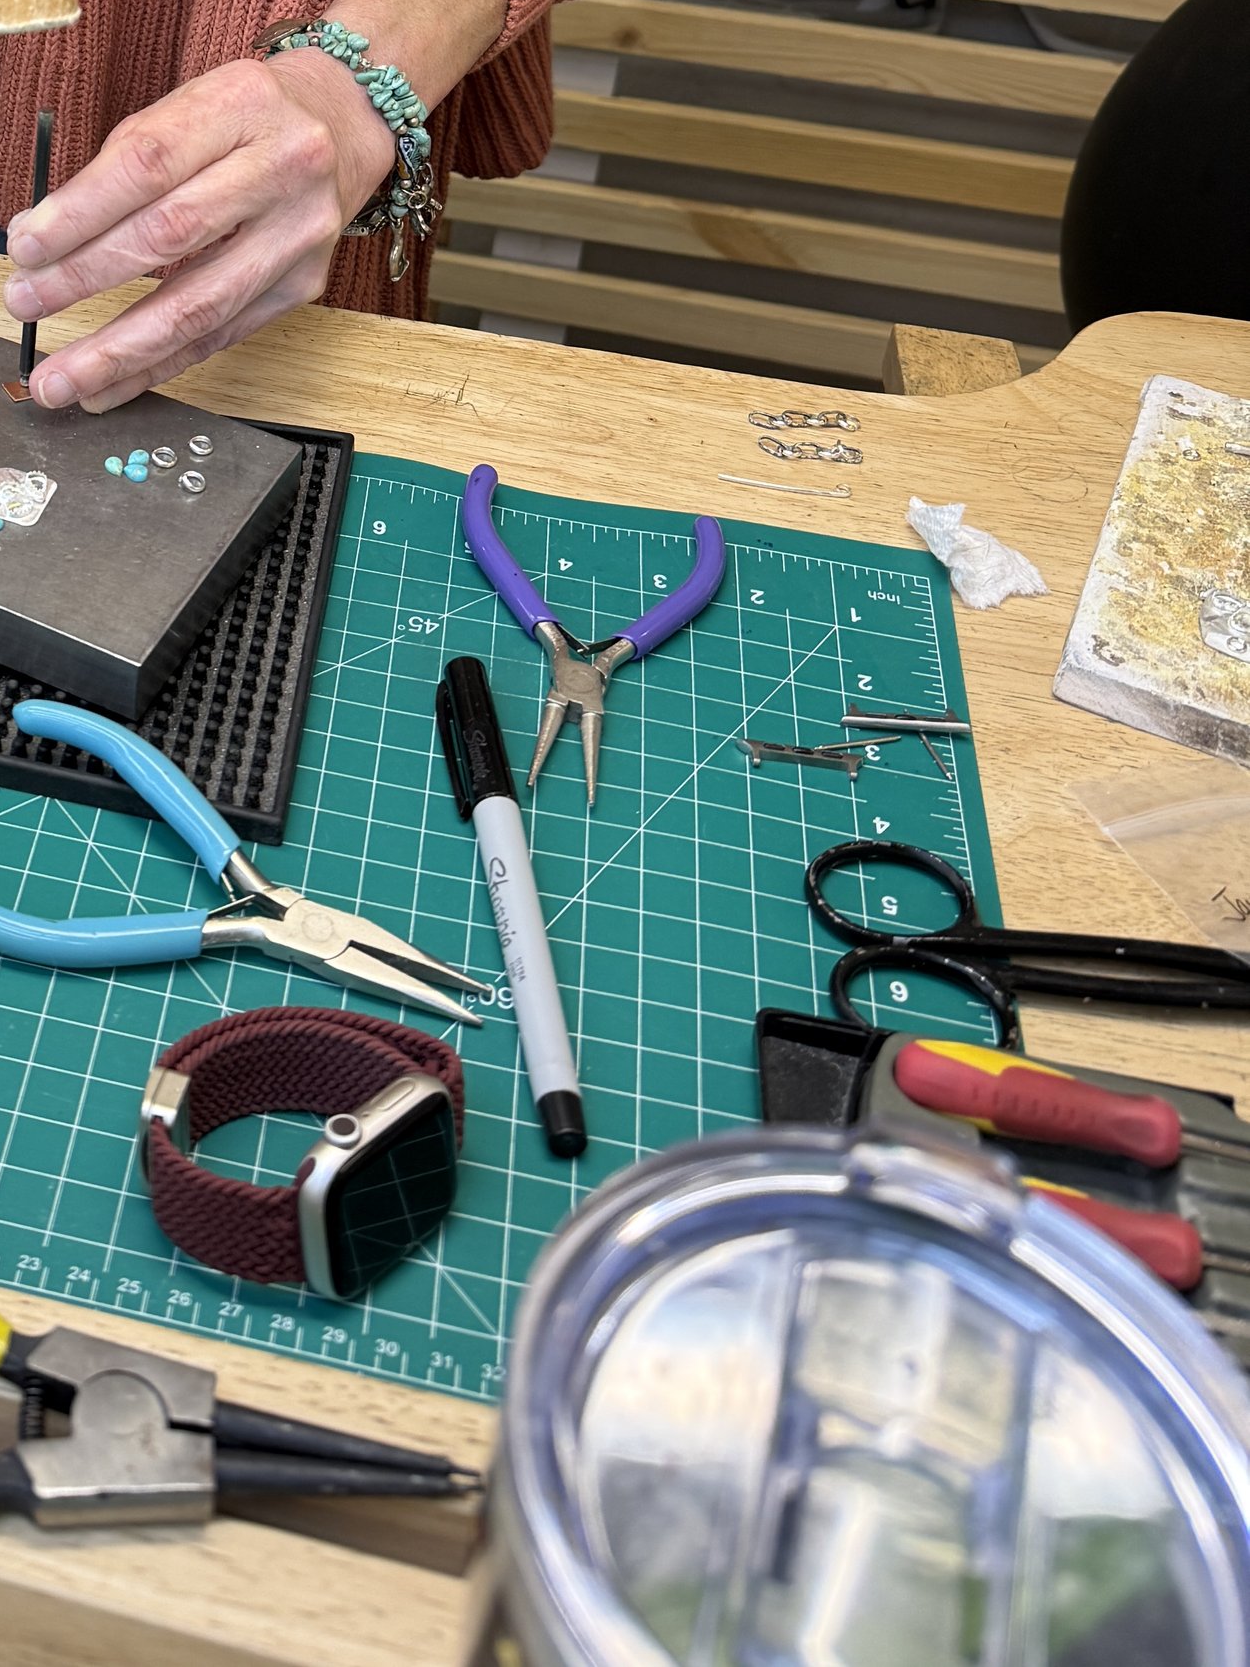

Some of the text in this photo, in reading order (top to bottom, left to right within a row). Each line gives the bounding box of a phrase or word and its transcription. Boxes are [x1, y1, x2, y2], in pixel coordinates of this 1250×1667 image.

[372, 520, 387, 535] 6
[558, 558, 862, 623] 4 3 2 1
[397, 615, 440, 635] 45°
[857, 674, 872, 691] 2
[865, 744, 881, 761] 3
[873, 816, 890, 835] 4
[881, 895, 898, 916] 5
[889, 980, 908, 1003] 6
[17, 1254, 42, 1271] 23
[67, 1266, 92, 1283] 24
[116, 1277, 142, 1294] 25
[167, 1289, 193, 1307] 26
[218, 1301, 244, 1318] 27
[270, 1314, 296, 1331] 28
[321, 1325, 347, 1344] 29
[374, 1338, 400, 1356] 30
[430, 1351, 454, 1368] 31
